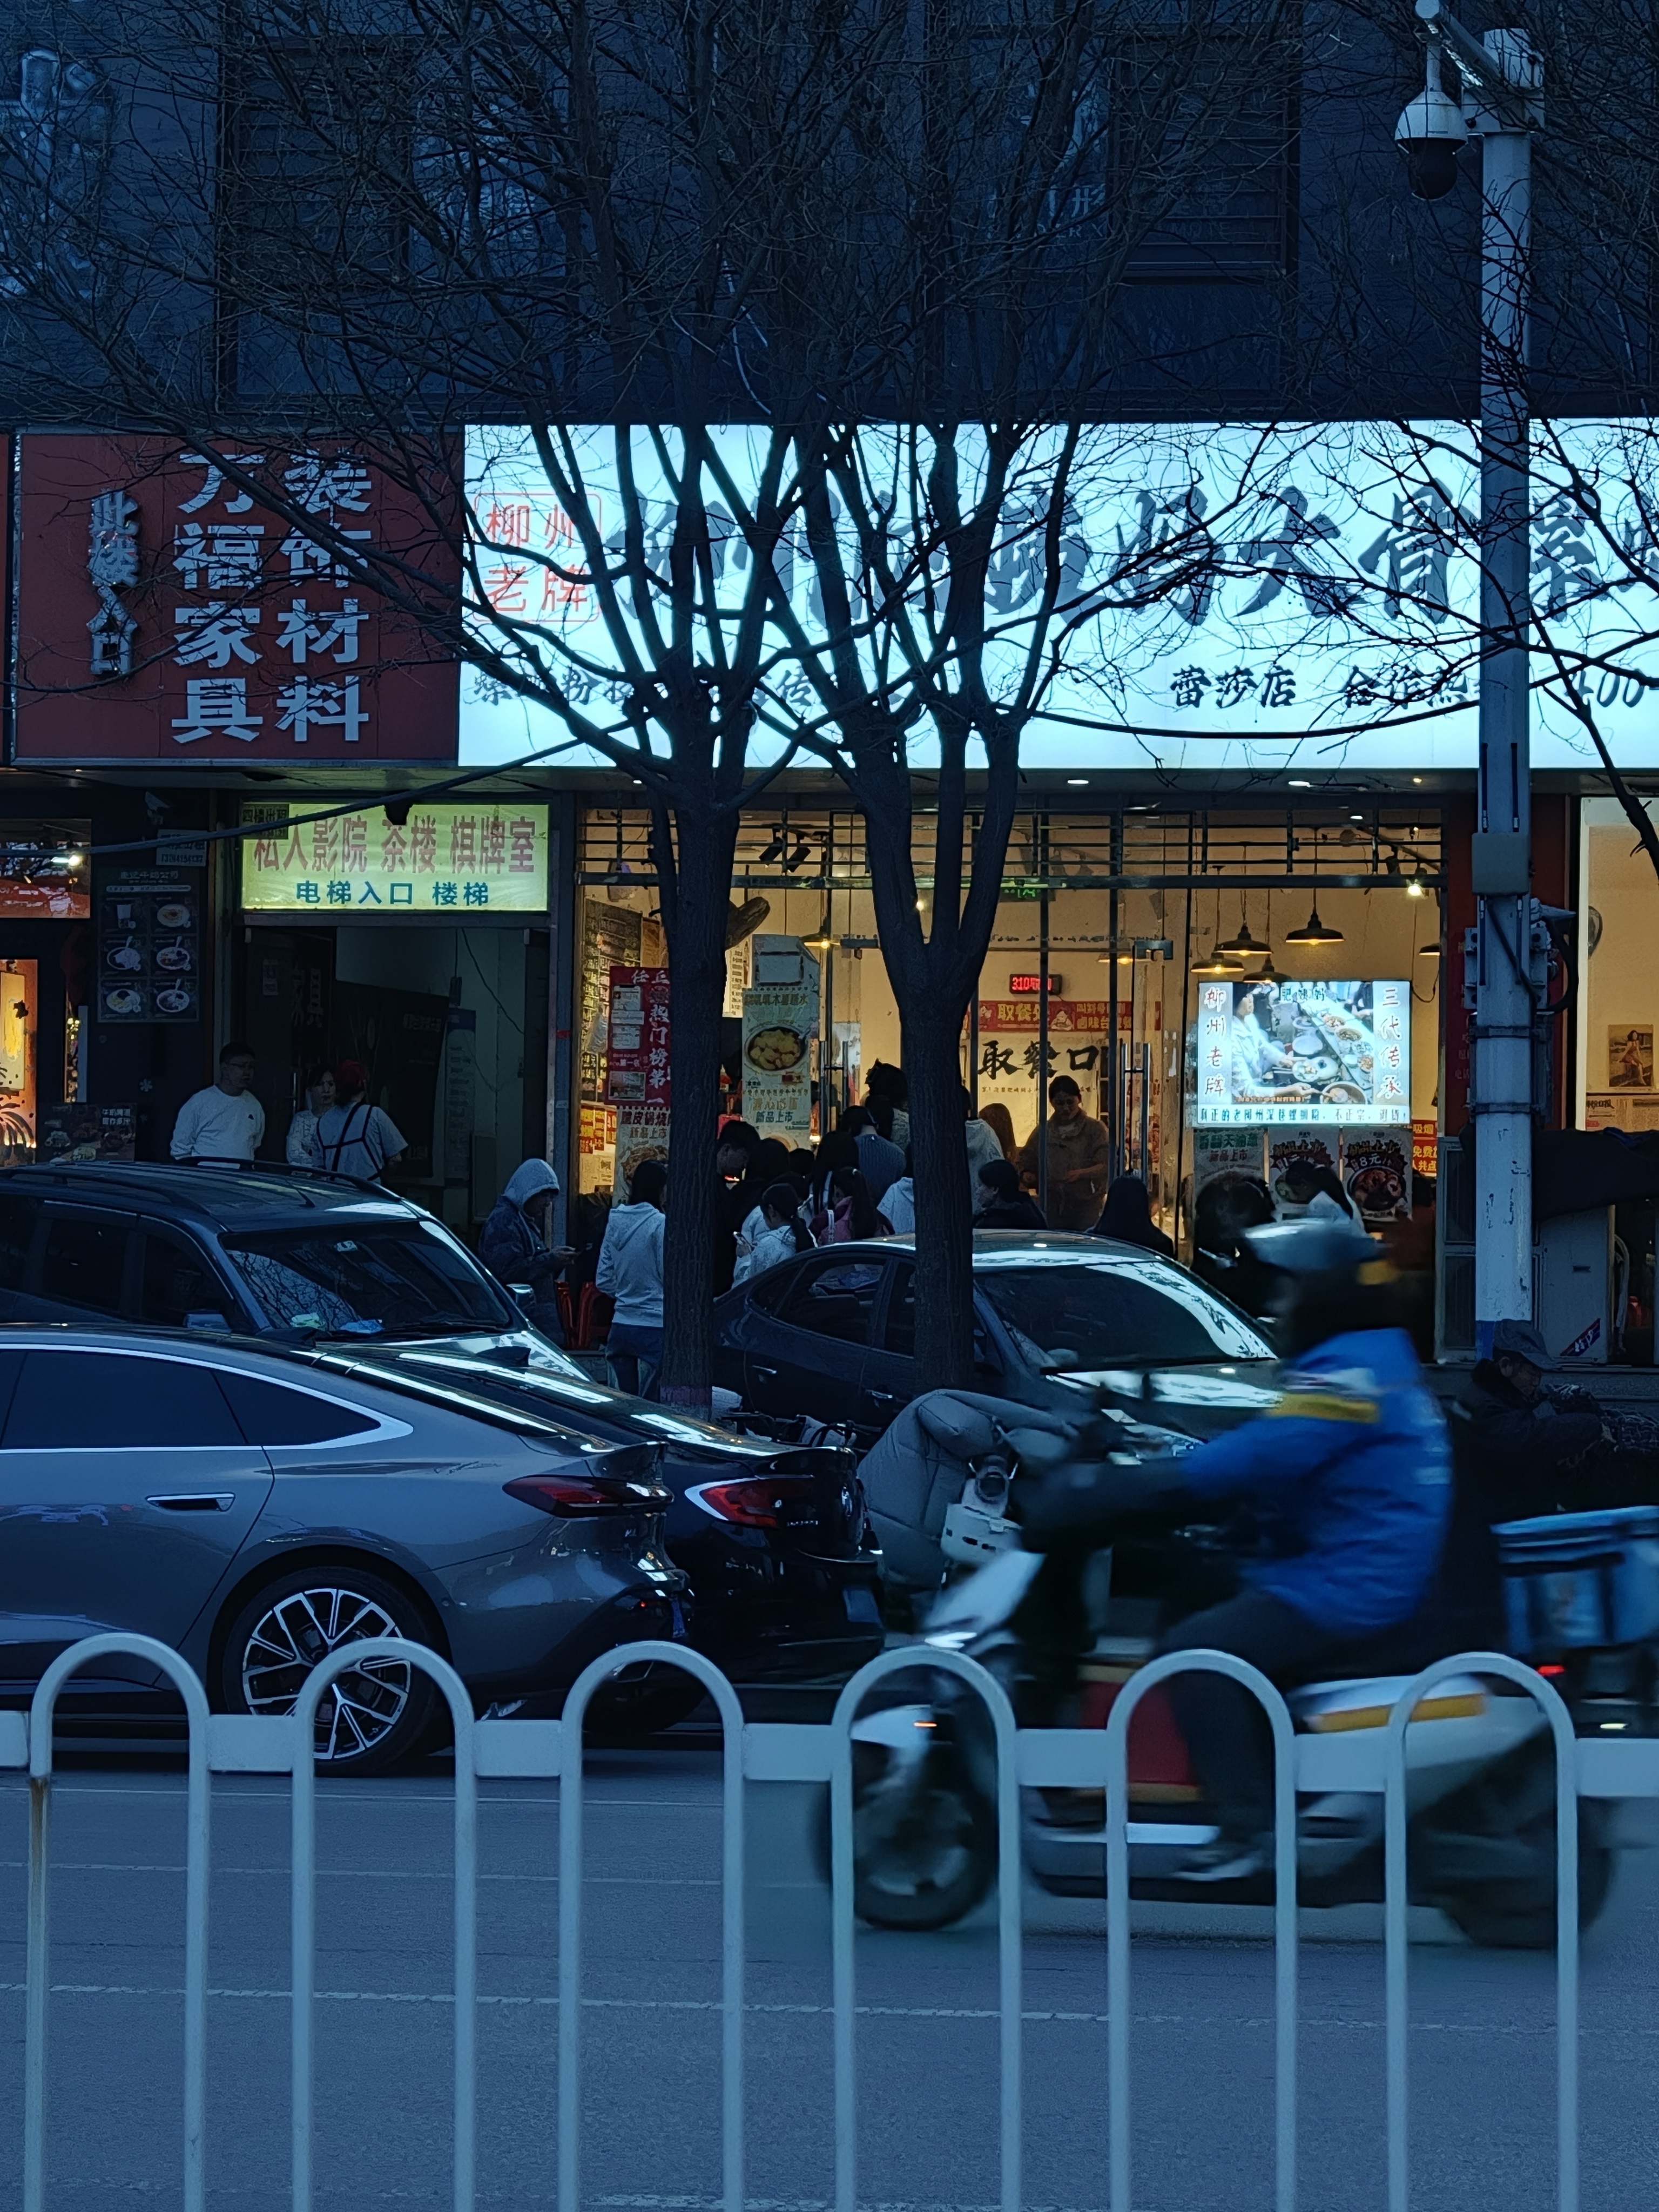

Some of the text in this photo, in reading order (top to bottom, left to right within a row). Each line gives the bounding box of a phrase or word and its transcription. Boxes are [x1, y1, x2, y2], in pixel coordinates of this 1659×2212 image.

[485, 503, 576, 549] 柳州
[484, 564, 589, 612] 老牌
[254, 815, 535, 874] 私人影院 茶楼 棋牌室
[296, 881, 489, 906] 电梯入口 楼梯
[978, 1040, 1100, 1080] 取餐口
[1205, 987, 1225, 1097] 柳州老牌
[1379, 988, 1402, 1099] 三代传承
[756, 1111, 794, 1123] 新品上市
